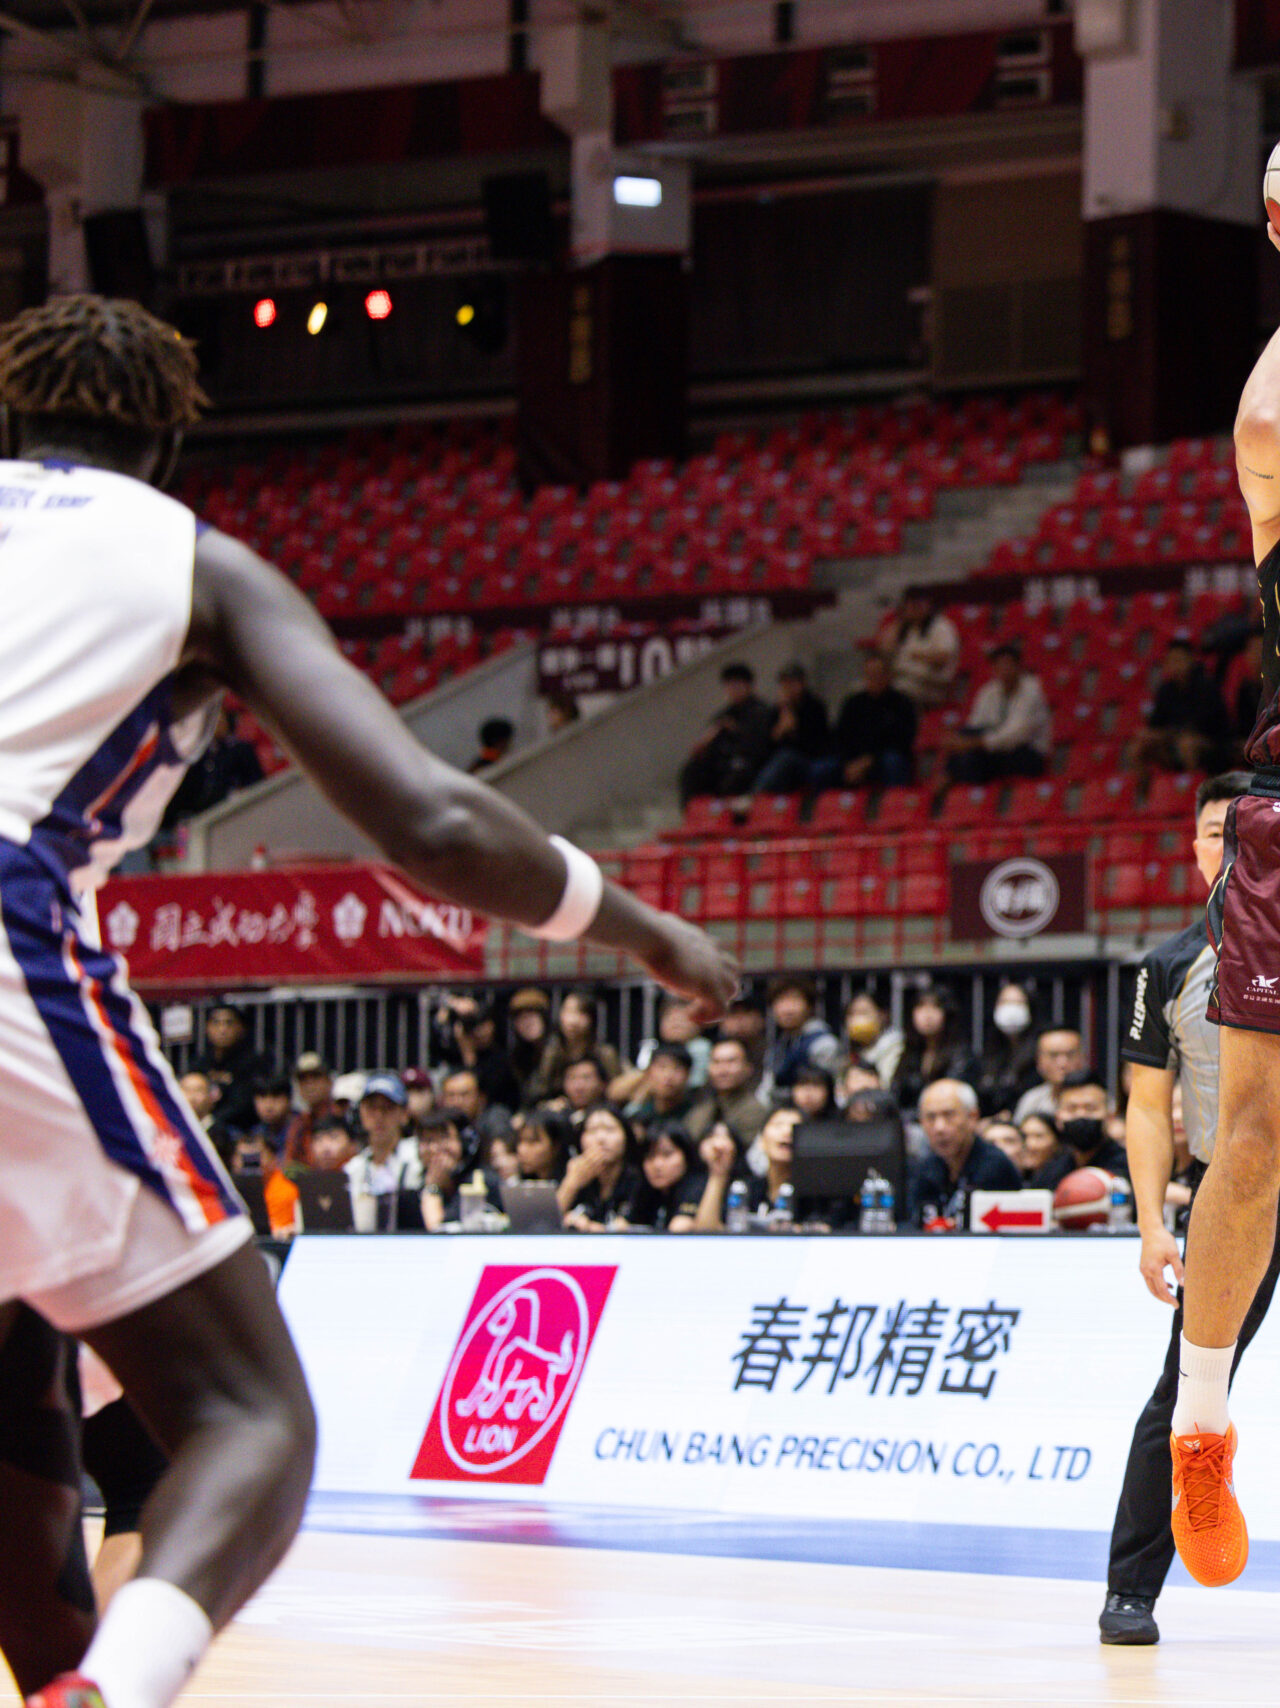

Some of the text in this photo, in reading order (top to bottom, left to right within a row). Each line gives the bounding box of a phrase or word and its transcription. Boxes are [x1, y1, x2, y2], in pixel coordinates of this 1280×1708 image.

[731, 1297, 1022, 1400] 春邦精密
[463, 1425, 519, 1454] LION
[594, 1428, 1092, 1485] CHUN BANG PRECISION CO., LTD
